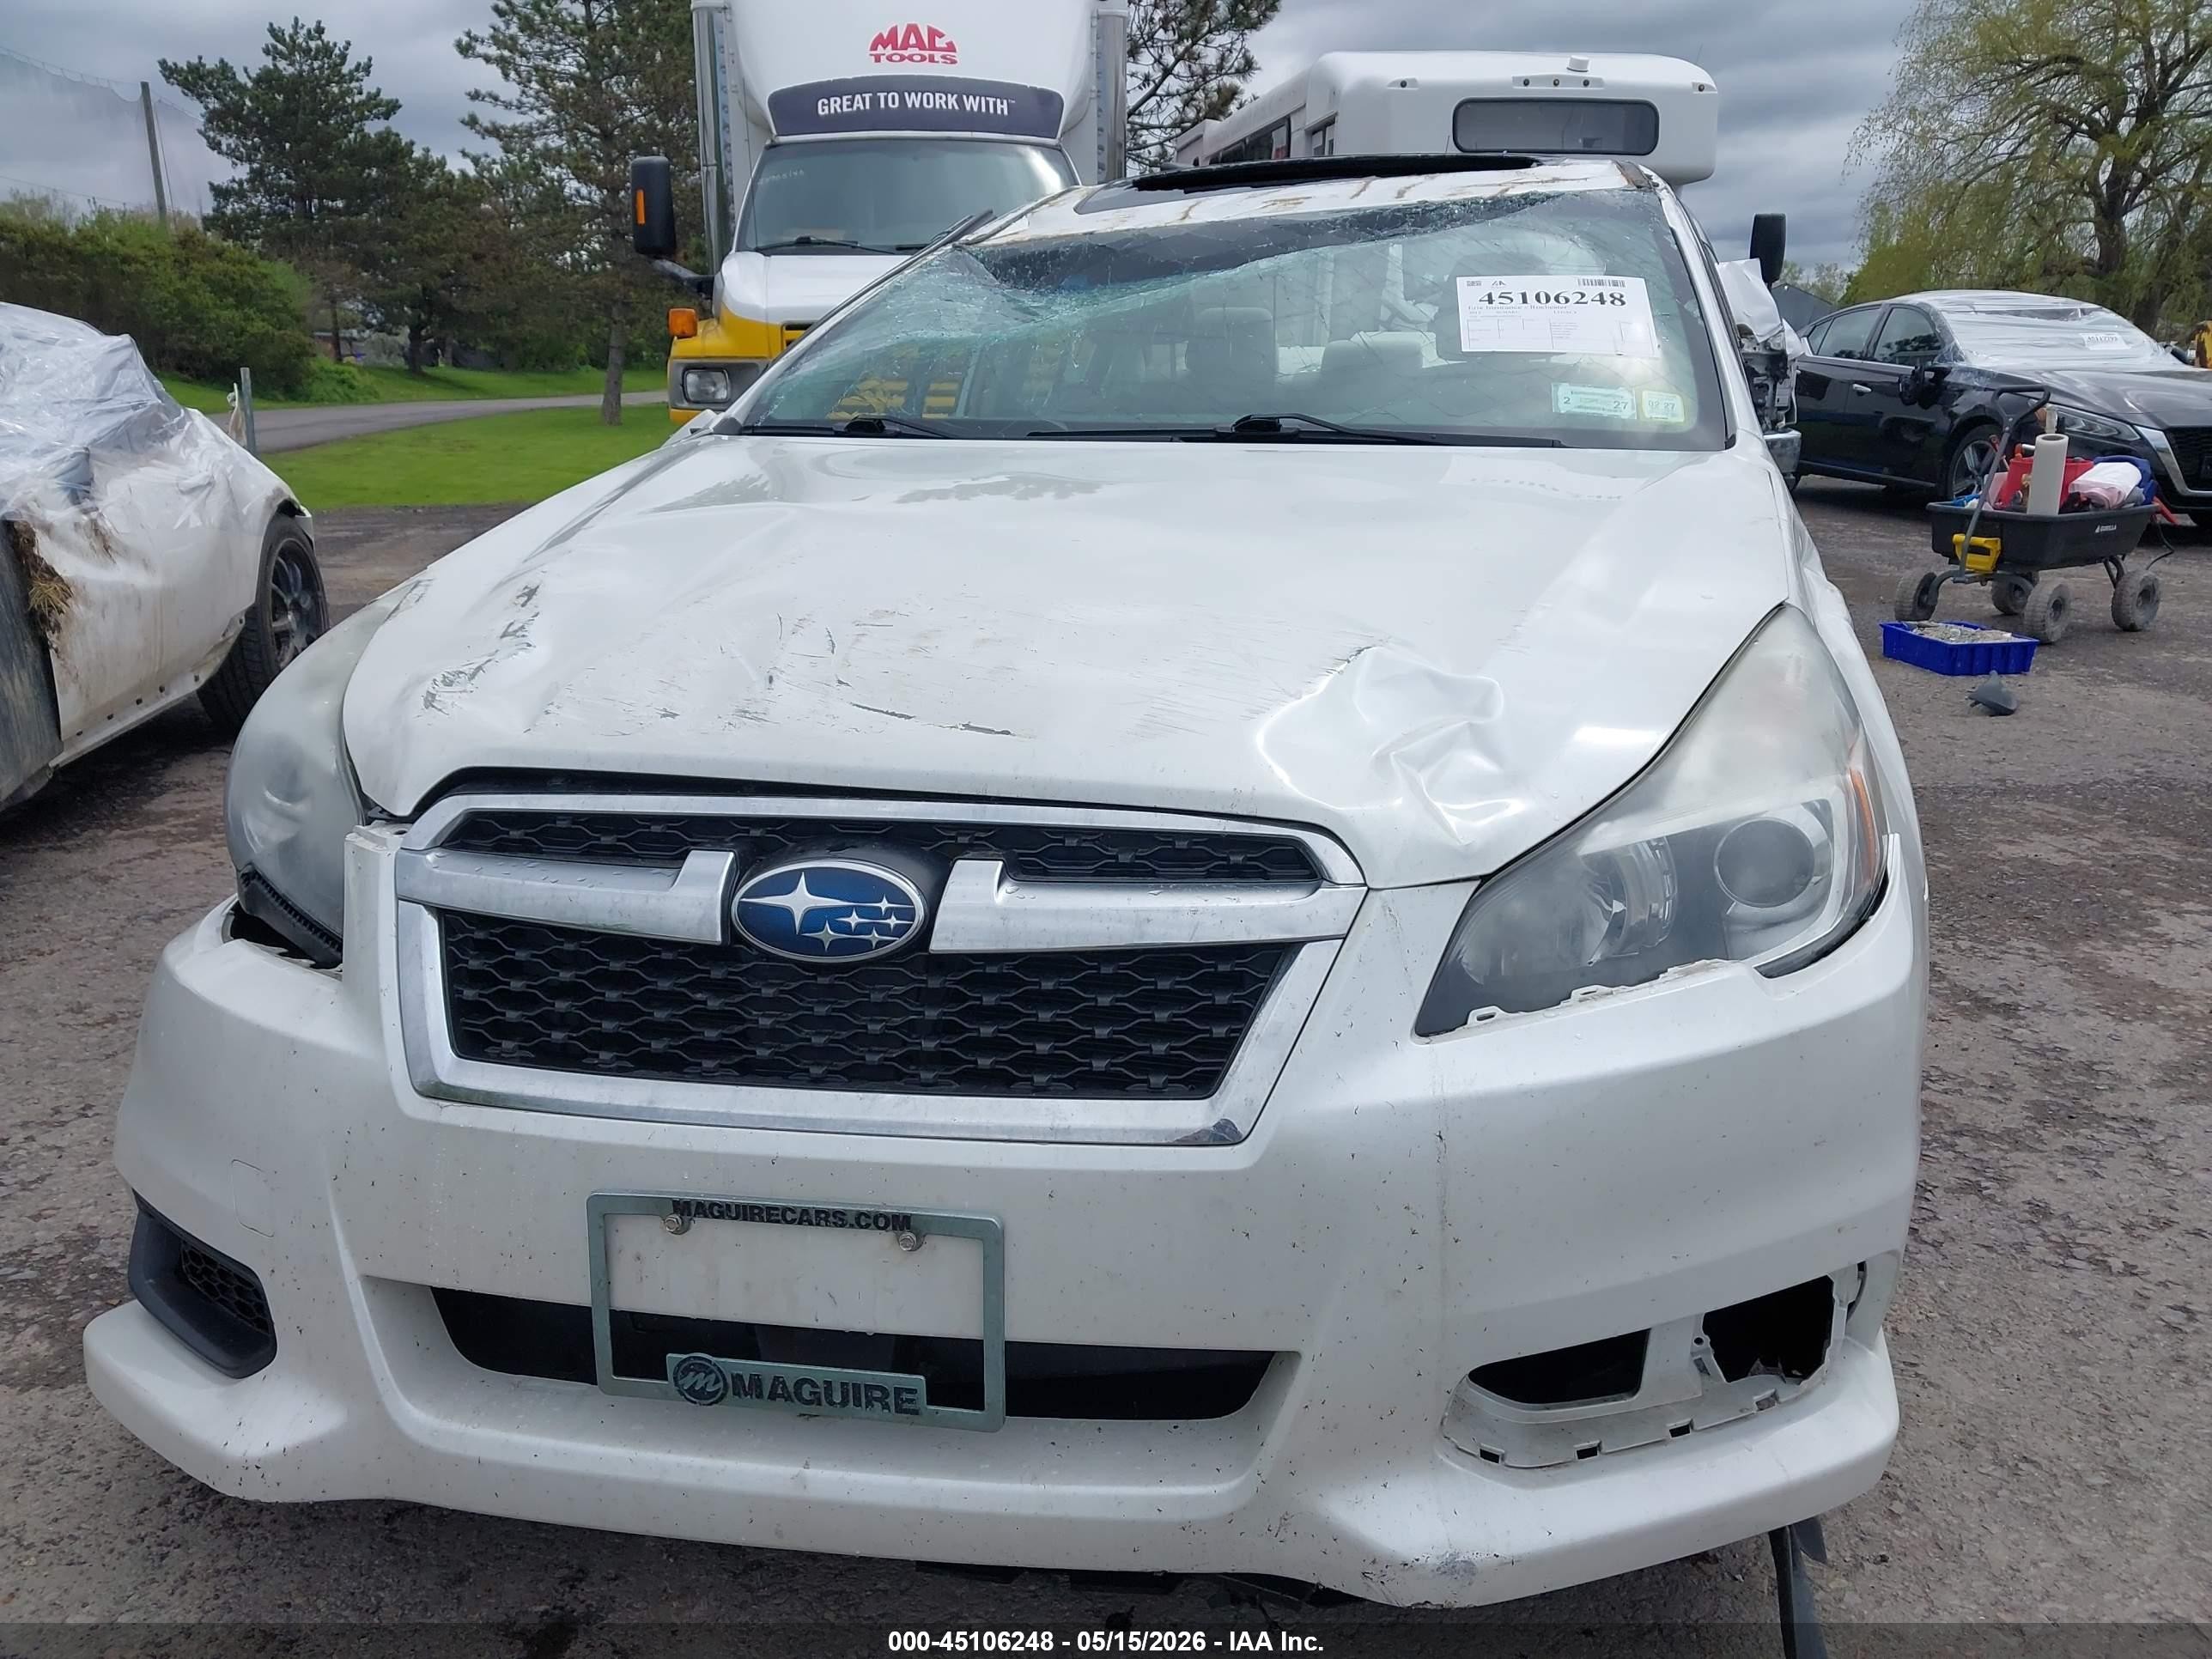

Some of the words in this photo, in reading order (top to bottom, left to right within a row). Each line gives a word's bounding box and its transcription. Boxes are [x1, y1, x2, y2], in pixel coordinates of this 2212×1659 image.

[869, 22, 957, 53] MAC
[869, 52, 958, 65] TOOLS
[817, 93, 872, 116] GREAT
[877, 92, 900, 109] TO
[904, 91, 960, 111] WORK
[1478, 290, 1627, 307] 45106248
[1613, 400, 1629, 410] 27
[672, 1200, 913, 1231] MAGUIRECARS.COM
[730, 1371, 921, 1416] MAGUIRE
